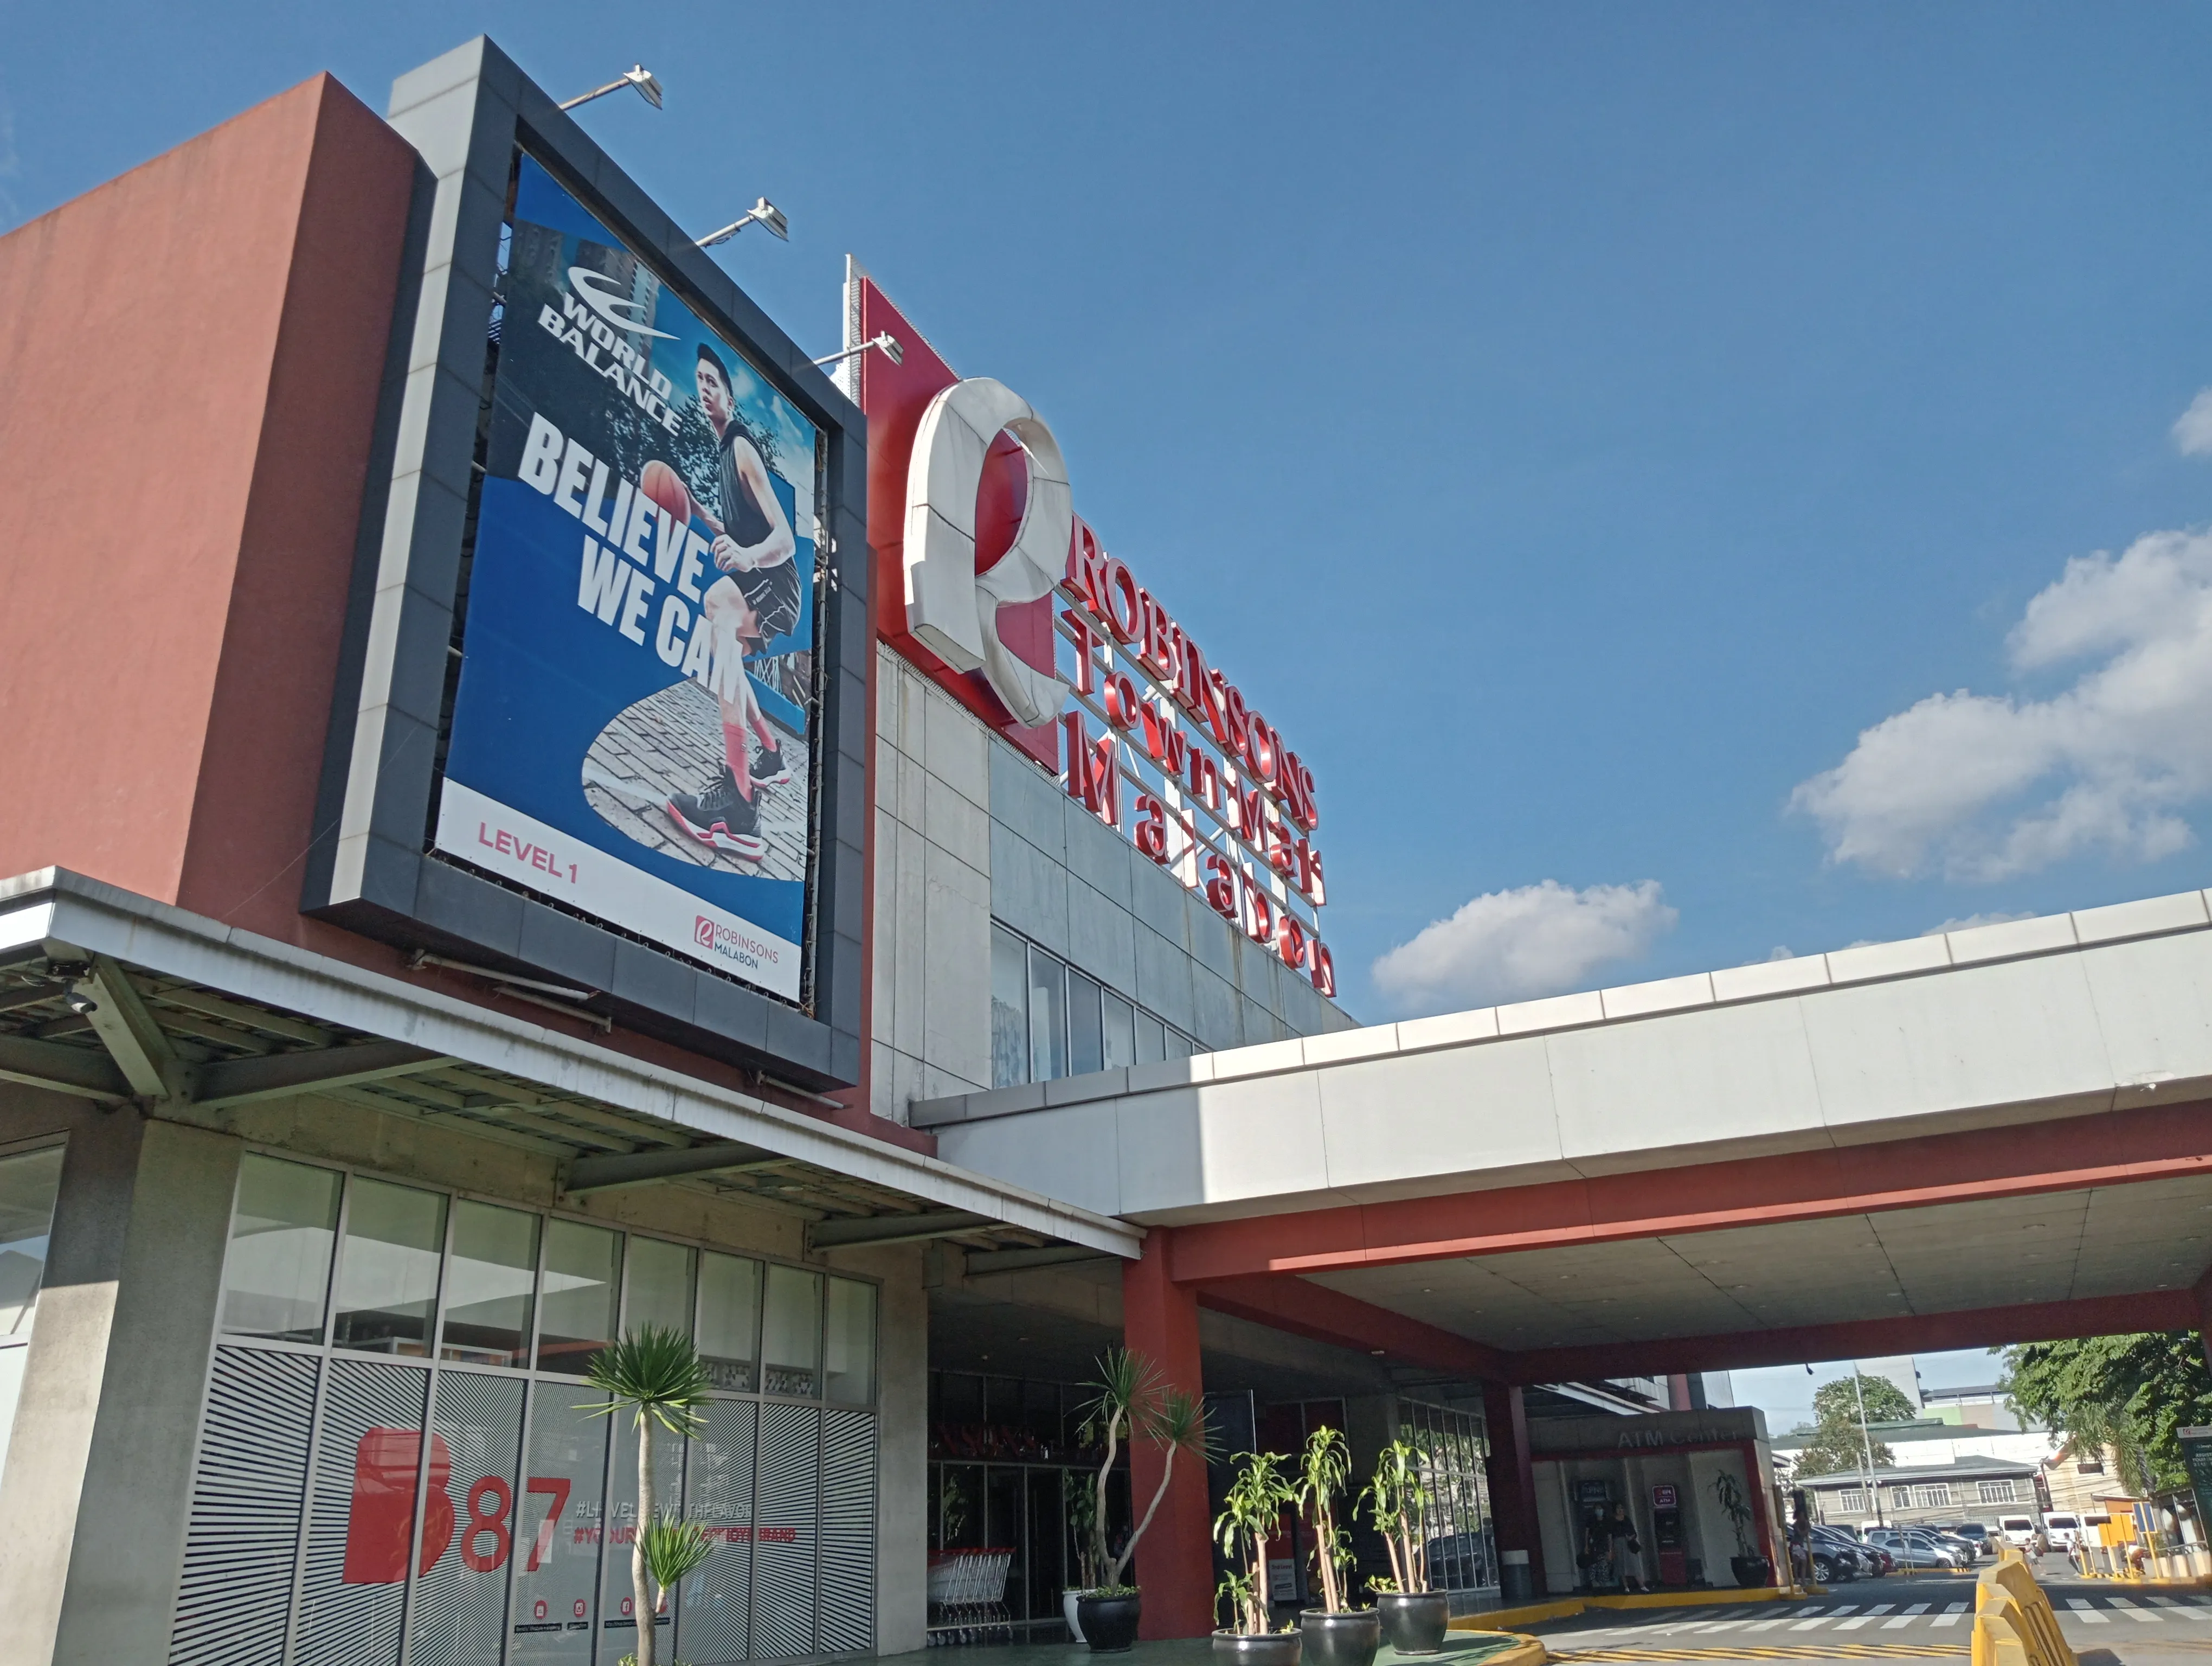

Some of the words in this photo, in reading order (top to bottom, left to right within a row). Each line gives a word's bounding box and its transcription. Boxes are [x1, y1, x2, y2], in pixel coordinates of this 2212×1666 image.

[537, 304, 683, 437] BALANCE
[563, 292, 673, 400] WORLD
[518, 412, 711, 604] BELIEVE
[577, 534, 655, 646] WE
[1059, 513, 1319, 831] ROBINSONS
[478, 822, 562, 878] LEVEL
[568, 863, 578, 884] 1
[1066, 710, 1337, 998] Malabon
[714, 941, 758, 970] MALABON
[715, 924, 779, 964] ROBINSONS
[1618, 1430, 1663, 1449] ATM
